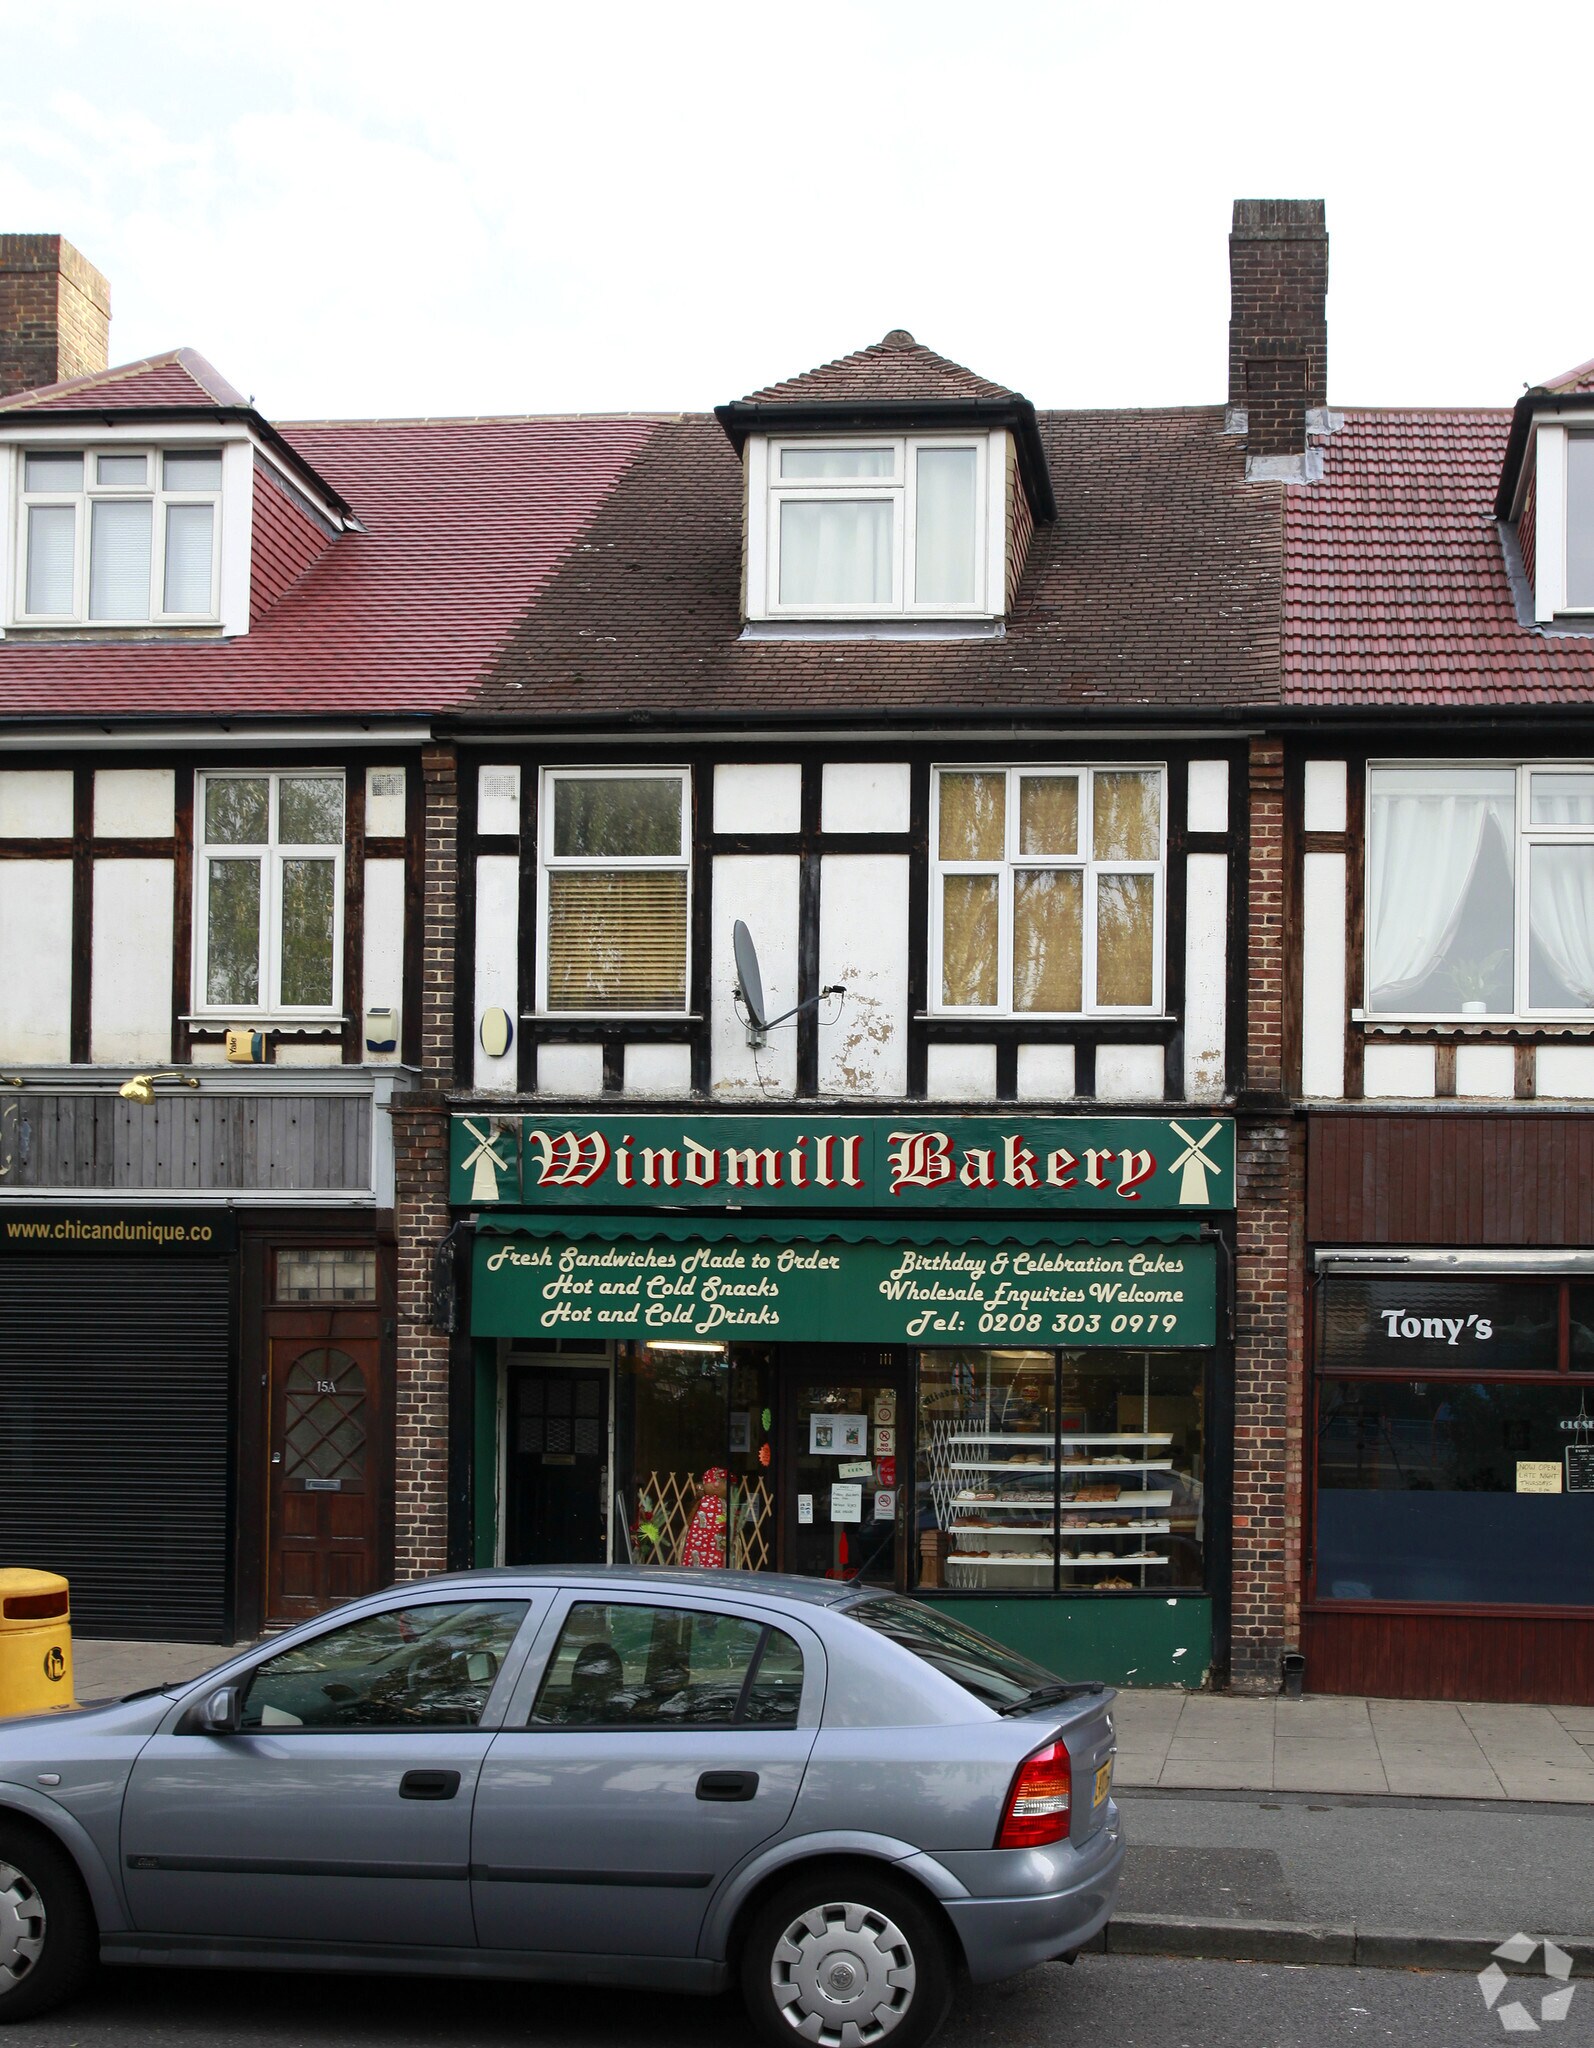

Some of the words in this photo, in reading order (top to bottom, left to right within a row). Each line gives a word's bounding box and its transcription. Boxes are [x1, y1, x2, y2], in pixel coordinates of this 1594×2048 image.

[229, 1037, 238, 1055] Yale
[529, 1131, 864, 1189] Windmill
[887, 1131, 1157, 1200] Bakery
[7, 1220, 212, 1245] www.chicandunique.co
[487, 1246, 553, 1271] Fresh
[559, 1247, 677, 1273] Sandwiches
[682, 1248, 746, 1274] Made
[752, 1253, 771, 1269] to
[777, 1249, 840, 1273] Order
[890, 1251, 986, 1281] Birthday
[990, 1253, 1010, 1275] &
[1012, 1253, 1124, 1275] Celebration
[1128, 1254, 1184, 1276] Cakes
[542, 1275, 594, 1300] Hot
[599, 1276, 642, 1295] and
[647, 1276, 697, 1299] Cold
[701, 1277, 779, 1302] Snacks
[879, 1280, 984, 1301] Wholesale
[983, 1282, 1086, 1311] Enquiries
[1089, 1283, 1184, 1303] Welcome
[541, 1302, 592, 1328] Hot
[598, 1303, 641, 1323] and
[645, 1303, 695, 1327] Cold
[694, 1303, 780, 1334] Drinks
[906, 1311, 965, 1337] Tel:
[978, 1313, 1042, 1333] 0208
[1051, 1314, 1102, 1333] 303
[1110, 1315, 1177, 1333] 0919
[1381, 1308, 1493, 1345] Tony's
[316, 1380, 337, 1393] 15A
[1518, 1463, 1536, 1472] NOW
